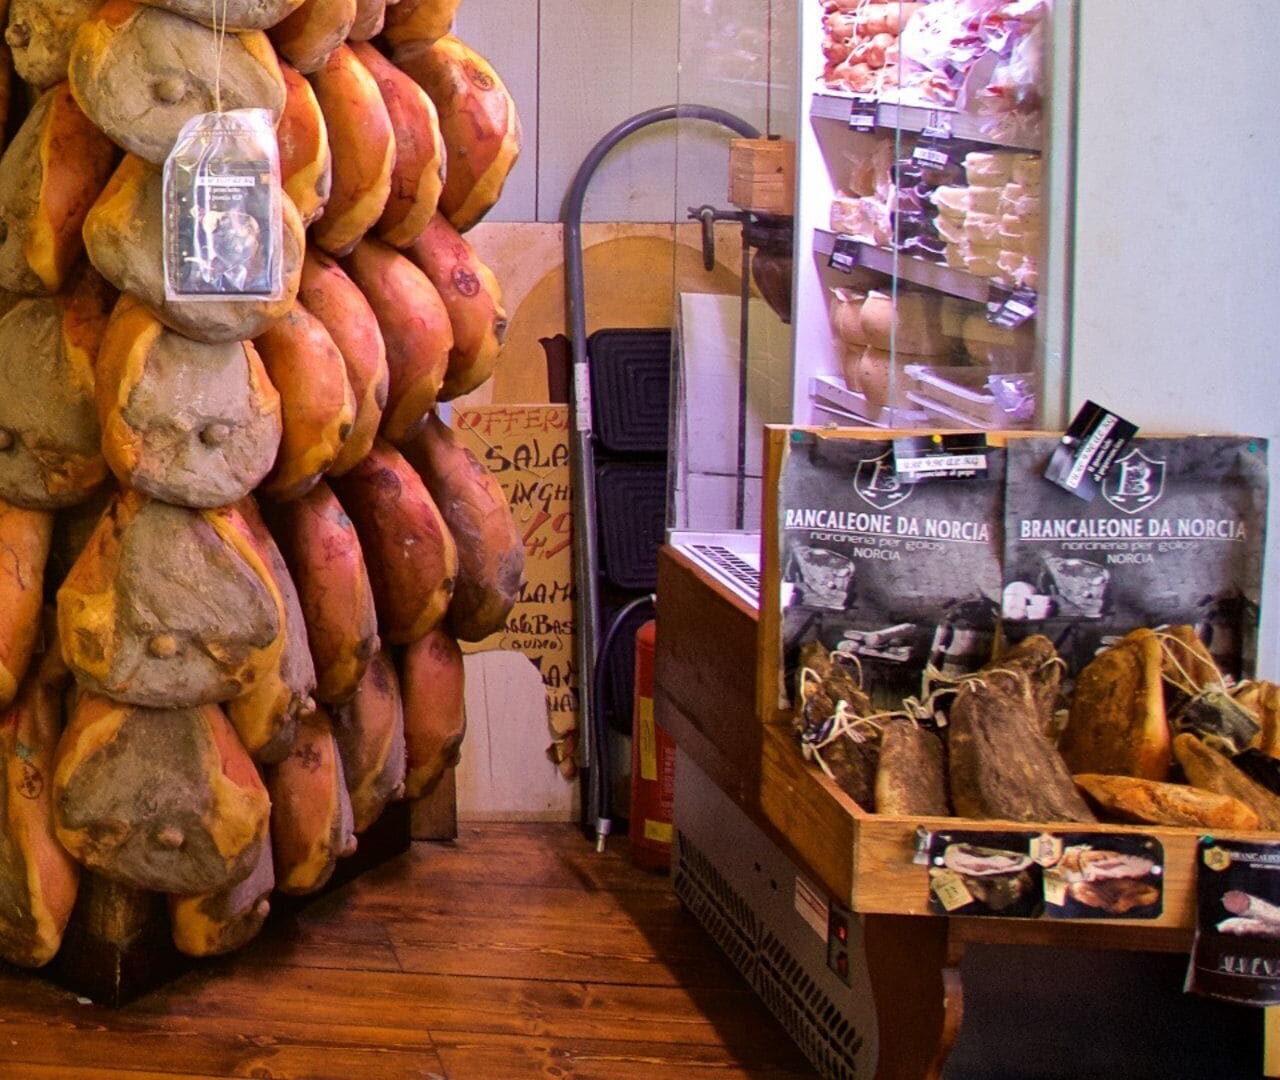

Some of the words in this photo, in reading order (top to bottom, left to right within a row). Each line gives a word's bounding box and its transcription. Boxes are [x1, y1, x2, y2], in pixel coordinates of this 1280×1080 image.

[457, 408, 569, 436] OFFER
[896, 517, 920, 536] DA
[925, 520, 989, 542] NORCIA
[1021, 519, 1144, 538] BRANCALEONE
[1148, 520, 1172, 537] DA
[1178, 519, 1247, 539] NORCIA
[878, 538, 902, 549] per
[1131, 541, 1153, 552] per
[853, 547, 901, 562] NORCIA
[1107, 553, 1155, 564] NORCIA
